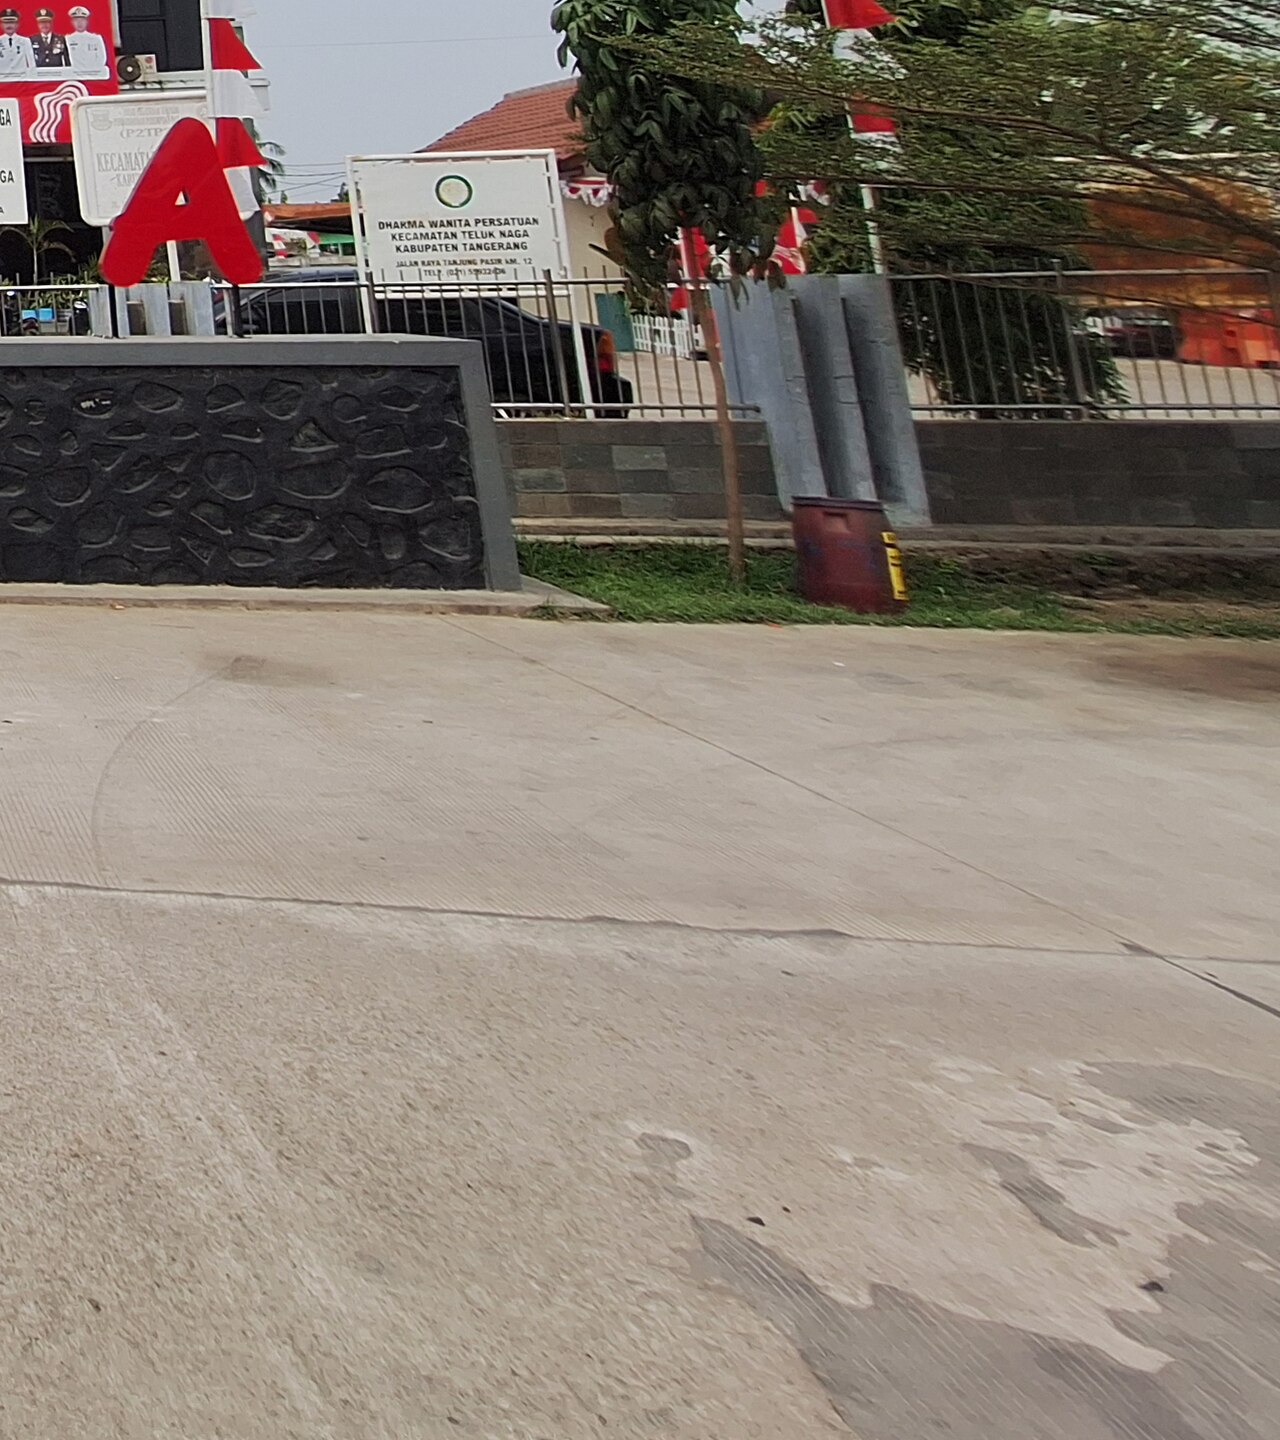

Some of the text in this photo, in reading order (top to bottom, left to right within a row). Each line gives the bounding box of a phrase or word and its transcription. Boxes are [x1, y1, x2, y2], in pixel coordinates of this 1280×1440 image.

[428, 218, 471, 229] WANITA
[474, 217, 540, 227] PERSATUAN
[391, 229, 530, 242] KECAMATAN TELUK NAGA
[395, 242, 528, 253] KABUPATEN TANGERANG
[396, 260, 419, 268] JALAN
[421, 259, 441, 267] RAYA
[443, 259, 478, 267] TANJUNG
[480, 258, 502, 266] PASIR
[523, 257, 533, 265] 12
